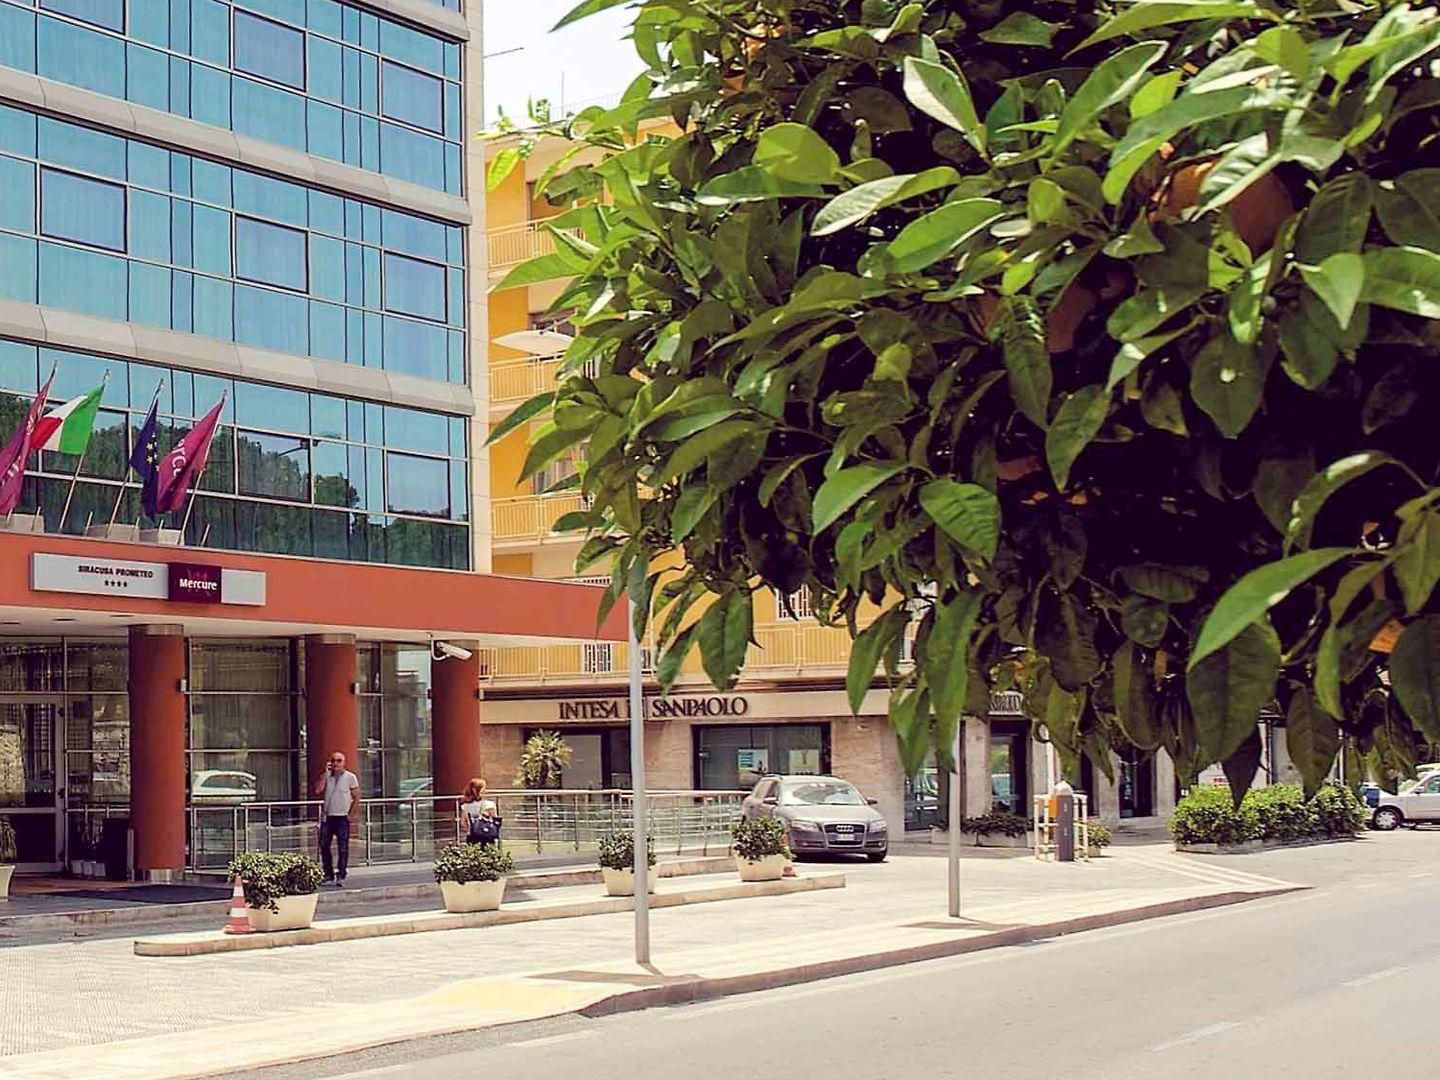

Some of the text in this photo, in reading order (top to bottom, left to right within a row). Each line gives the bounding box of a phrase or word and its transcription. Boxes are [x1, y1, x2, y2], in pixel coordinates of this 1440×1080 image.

[78, 565, 153, 578] SIRACUSA PROMETEO
[179, 578, 218, 590] Mercure
[559, 697, 747, 719] INTESA SANPAOLO
